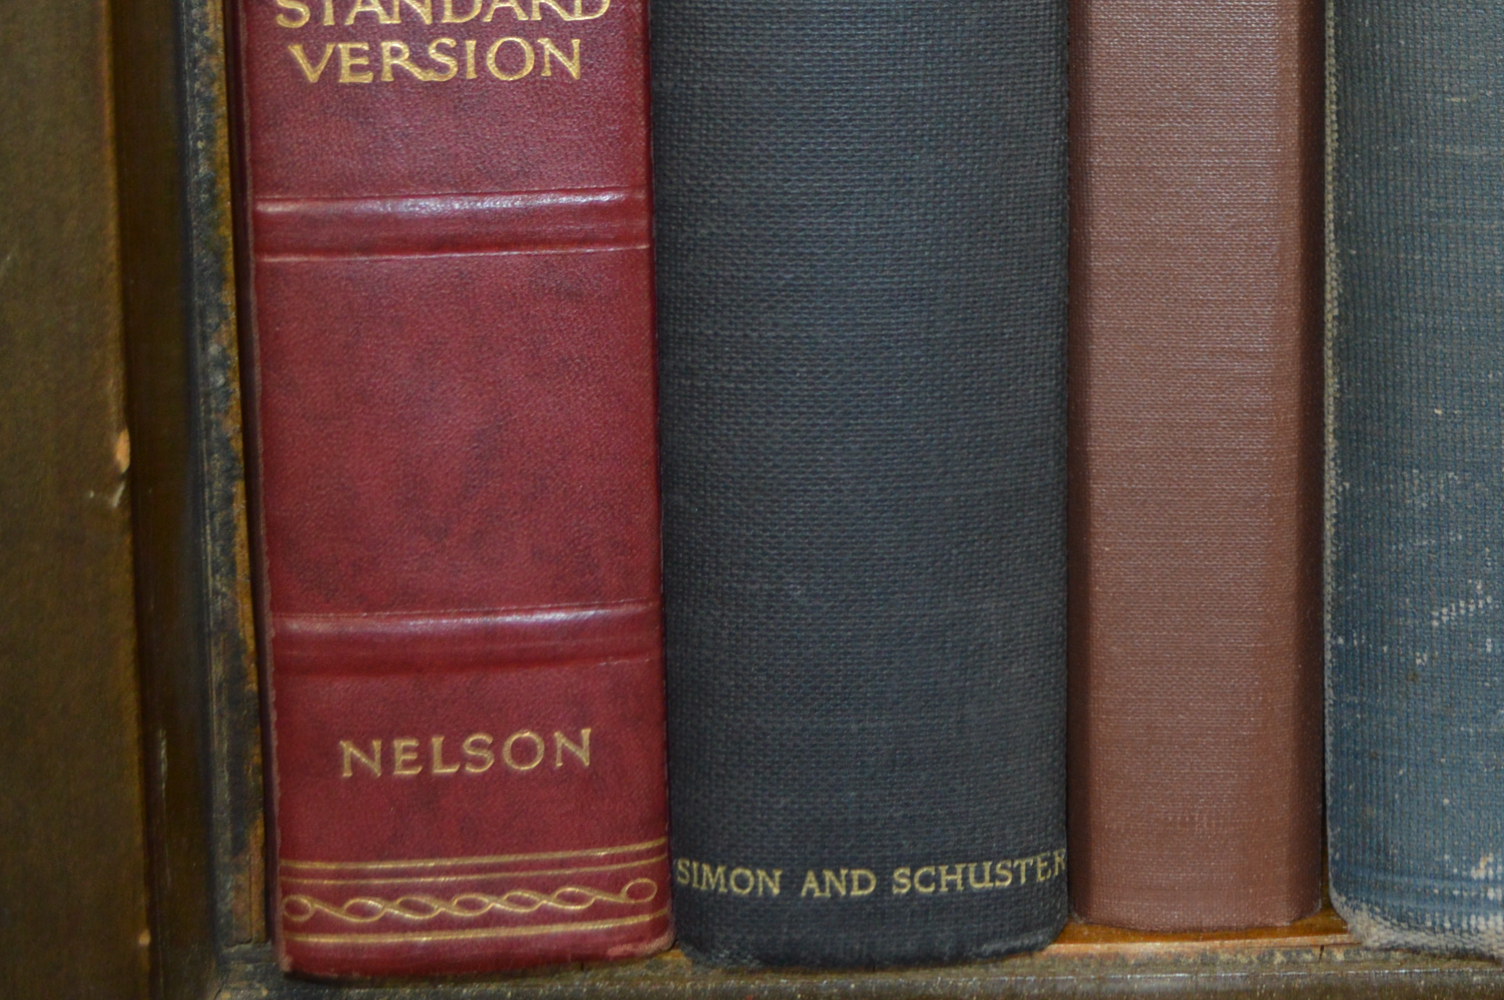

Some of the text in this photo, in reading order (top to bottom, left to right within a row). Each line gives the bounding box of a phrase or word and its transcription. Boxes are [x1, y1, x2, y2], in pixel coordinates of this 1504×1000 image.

[288, 36, 582, 84] VERSION
[339, 727, 594, 779] NELSON
[676, 847, 1067, 899] SIMON AND SCHUSTER
